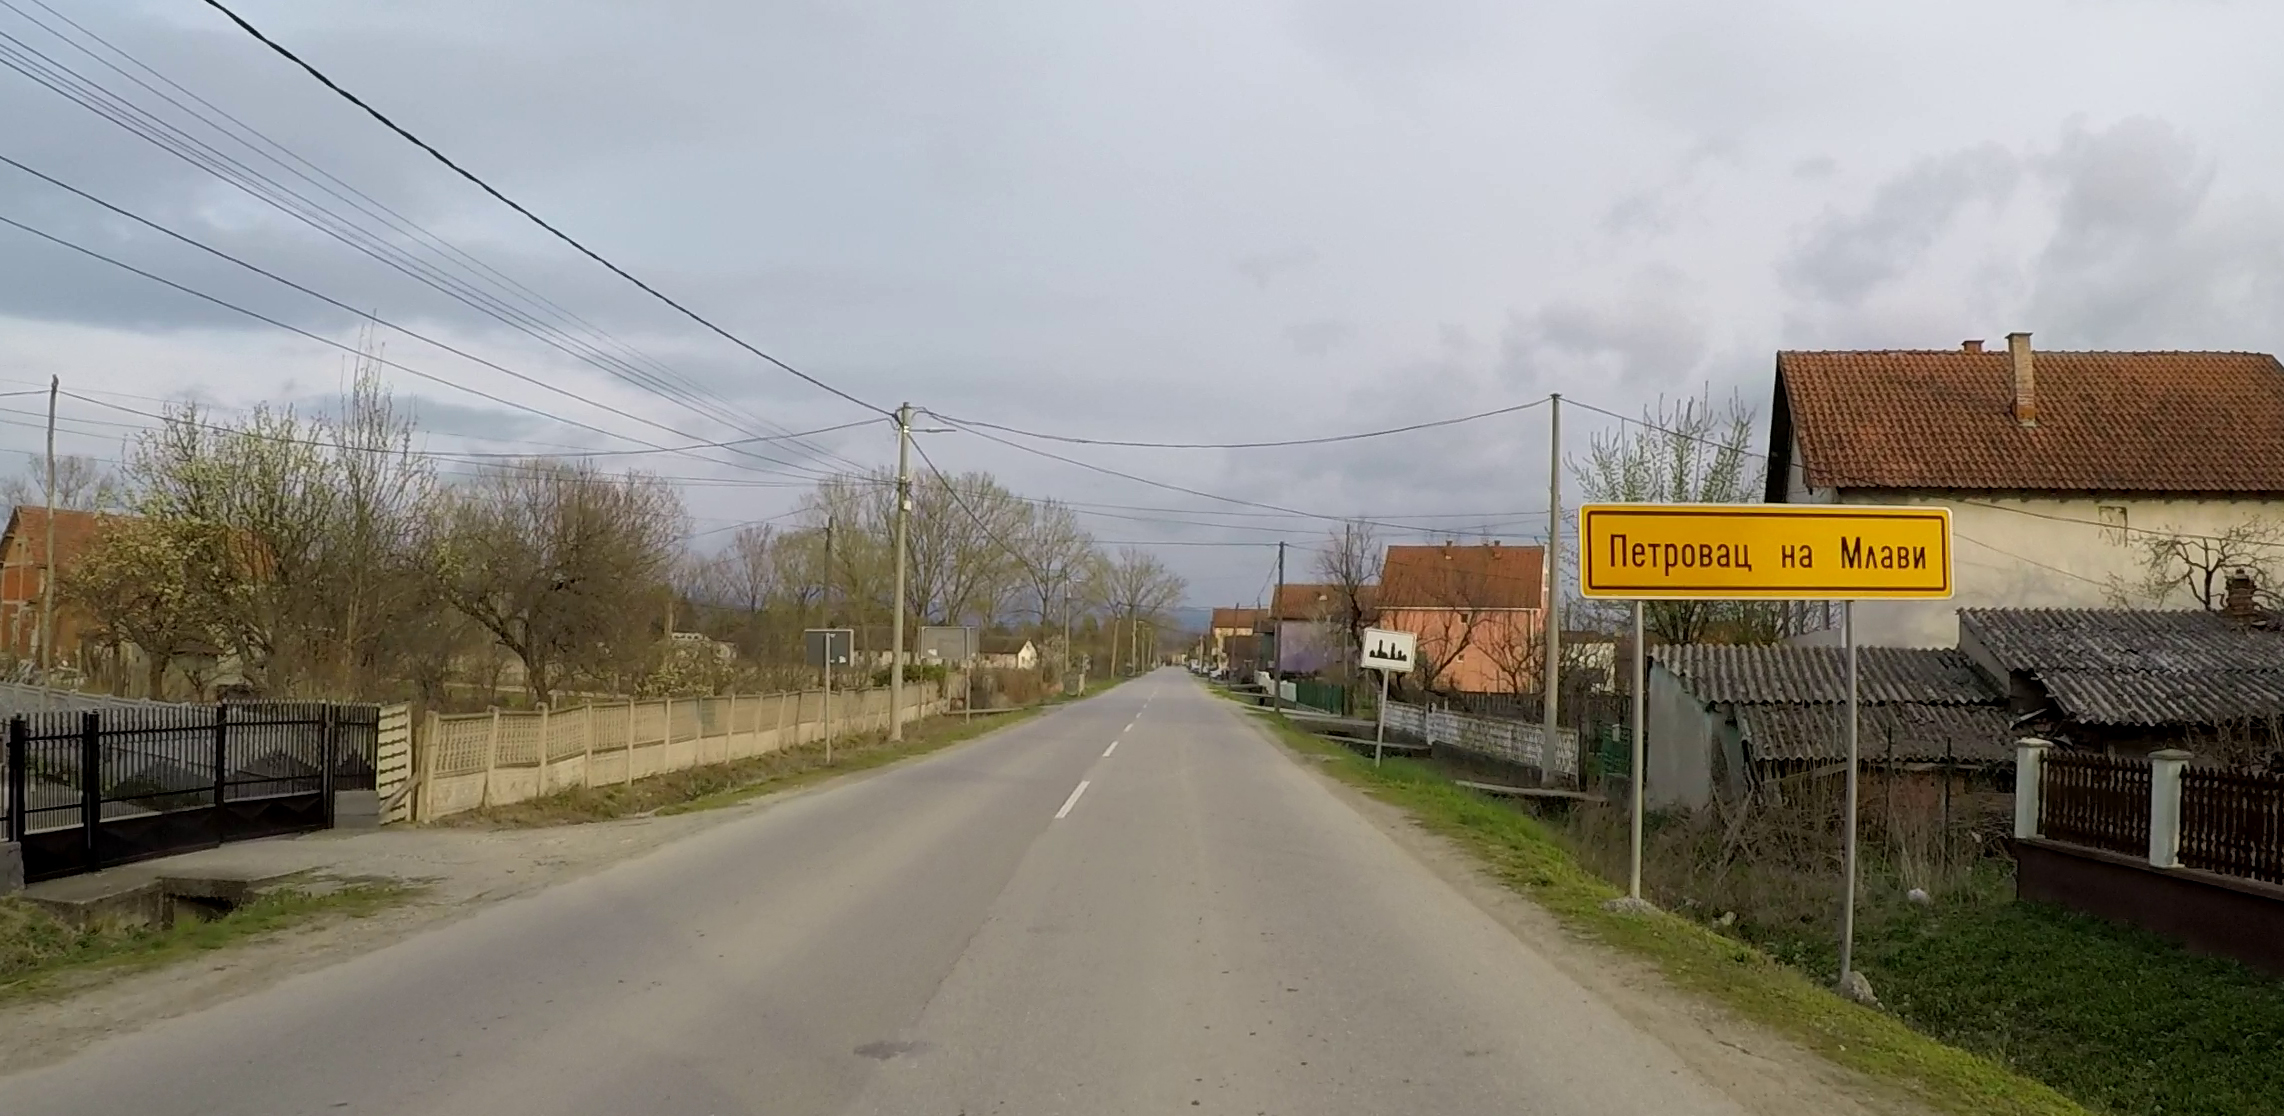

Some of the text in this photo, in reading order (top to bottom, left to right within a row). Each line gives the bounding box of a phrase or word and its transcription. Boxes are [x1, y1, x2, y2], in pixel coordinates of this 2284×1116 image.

[1609, 533, 1926, 576] Петровац на Млави
